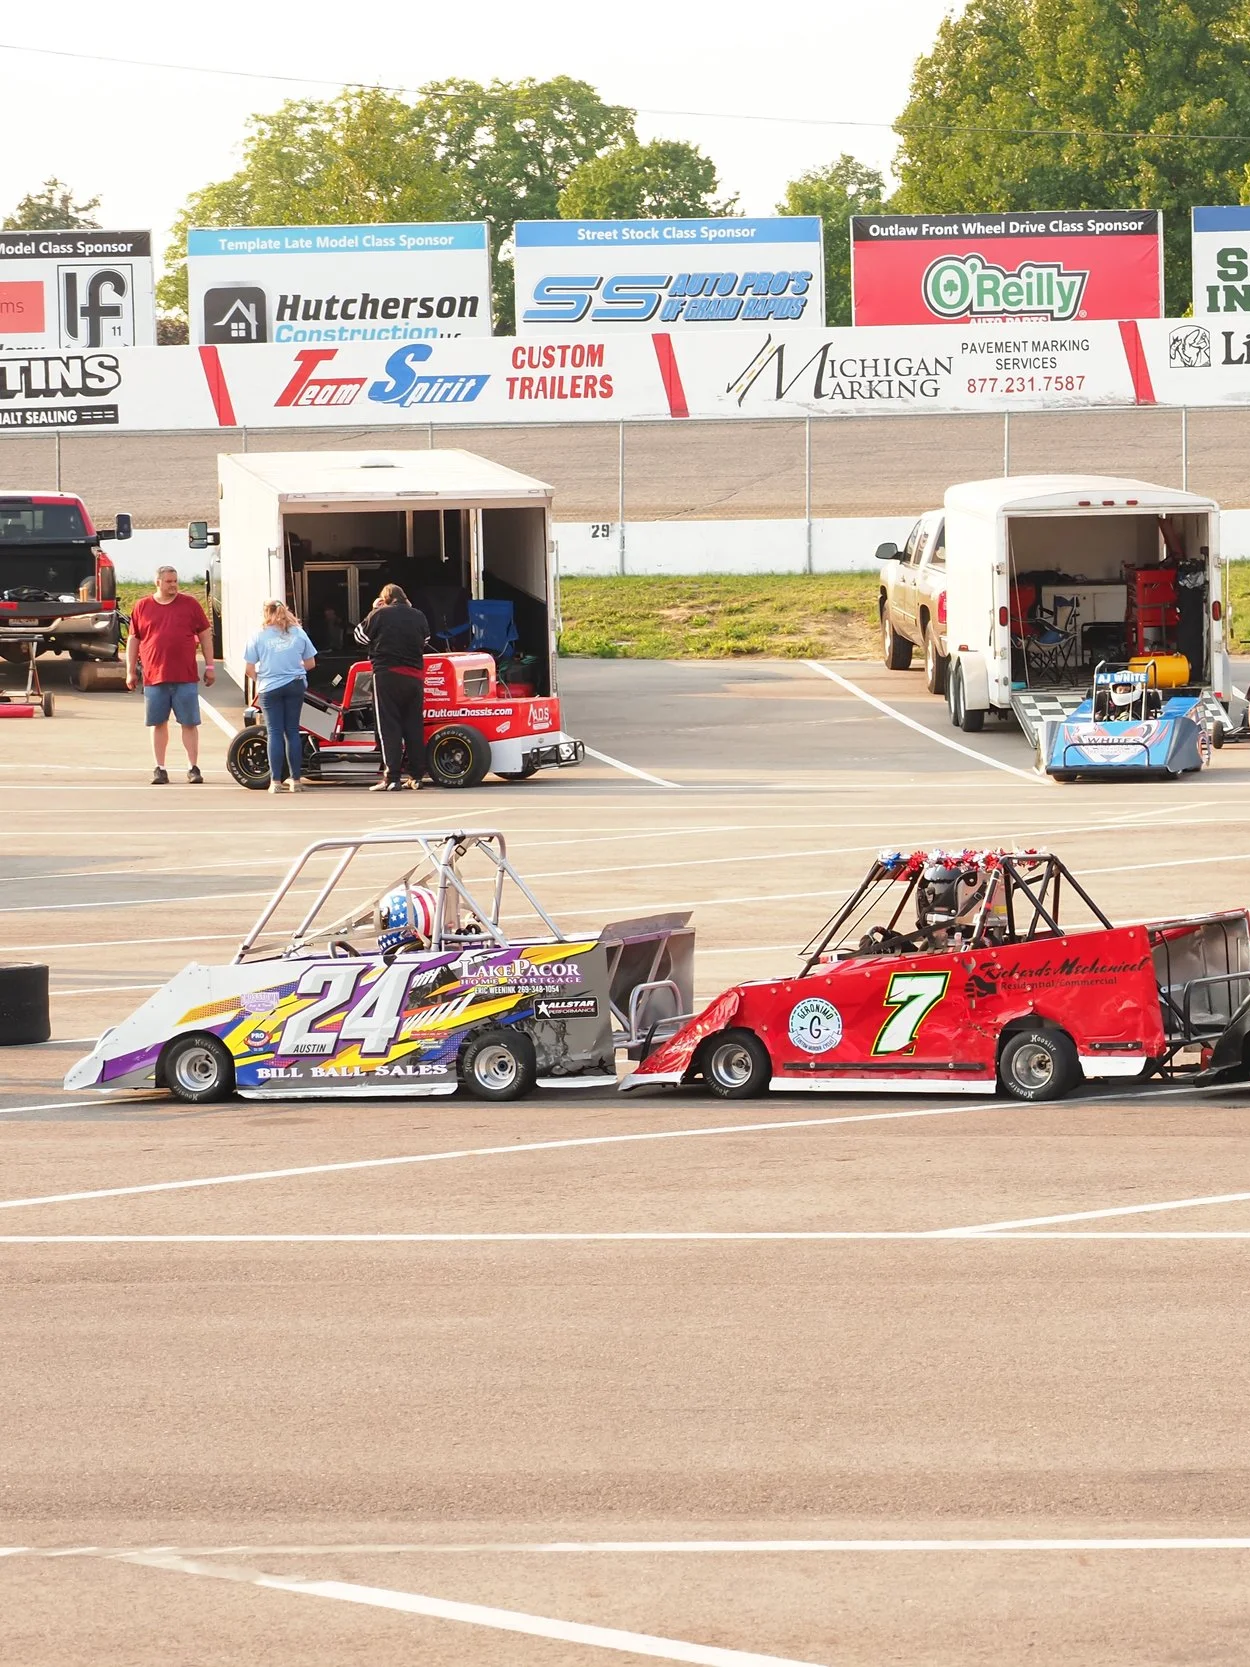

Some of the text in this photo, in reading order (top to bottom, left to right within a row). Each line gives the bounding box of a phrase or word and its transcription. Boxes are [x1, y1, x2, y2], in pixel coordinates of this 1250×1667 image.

[577, 225, 756, 242] Street Stock Class Sponsor
[869, 219, 1143, 237] Outlaw Front Wheel Drive Class Sponsor
[39, 242, 73, 254] Class
[78, 241, 133, 256] Sponsor
[219, 233, 454, 252] Template Late Model Class Sponsor
[668, 270, 813, 296] AUTO PRO'S
[931, 262, 1076, 313] O'Reilly
[522, 273, 671, 322] SS
[276, 293, 479, 321] Hutcherson
[659, 296, 809, 321] OF GRAND RAPIDS
[111, 326, 122, 337] 11
[275, 322, 438, 343] Construction
[961, 338, 1090, 355] PAVEMENT MARKING
[511, 343, 604, 370] CUSTOM
[995, 356, 1057, 371] SERVICES
[274, 343, 491, 408] Team Spirit
[506, 373, 614, 400] TRAILERS
[967, 375, 1086, 394] 877.231.7587
[25, 410, 78, 425] SEALING
[591, 524, 610, 539] 29
[1097, 672, 1148, 684] AJ WHITE
[427, 707, 513, 718] OutlawChassis.com
[1054, 956, 1150, 976] Mechanical
[508, 976, 582, 985] MORTGAGE
[474, 986, 488, 995] ERIC
[489, 985, 516, 994] WEENINK
[278, 963, 418, 1057] 24
[548, 1000, 595, 1009] ALLSTAR
[797, 1003, 834, 1020] GERONIMO
[870, 971, 952, 1057] 7
[293, 1044, 327, 1053] AUSTIN
[256, 1064, 449, 1079] BILL BALL SALES
